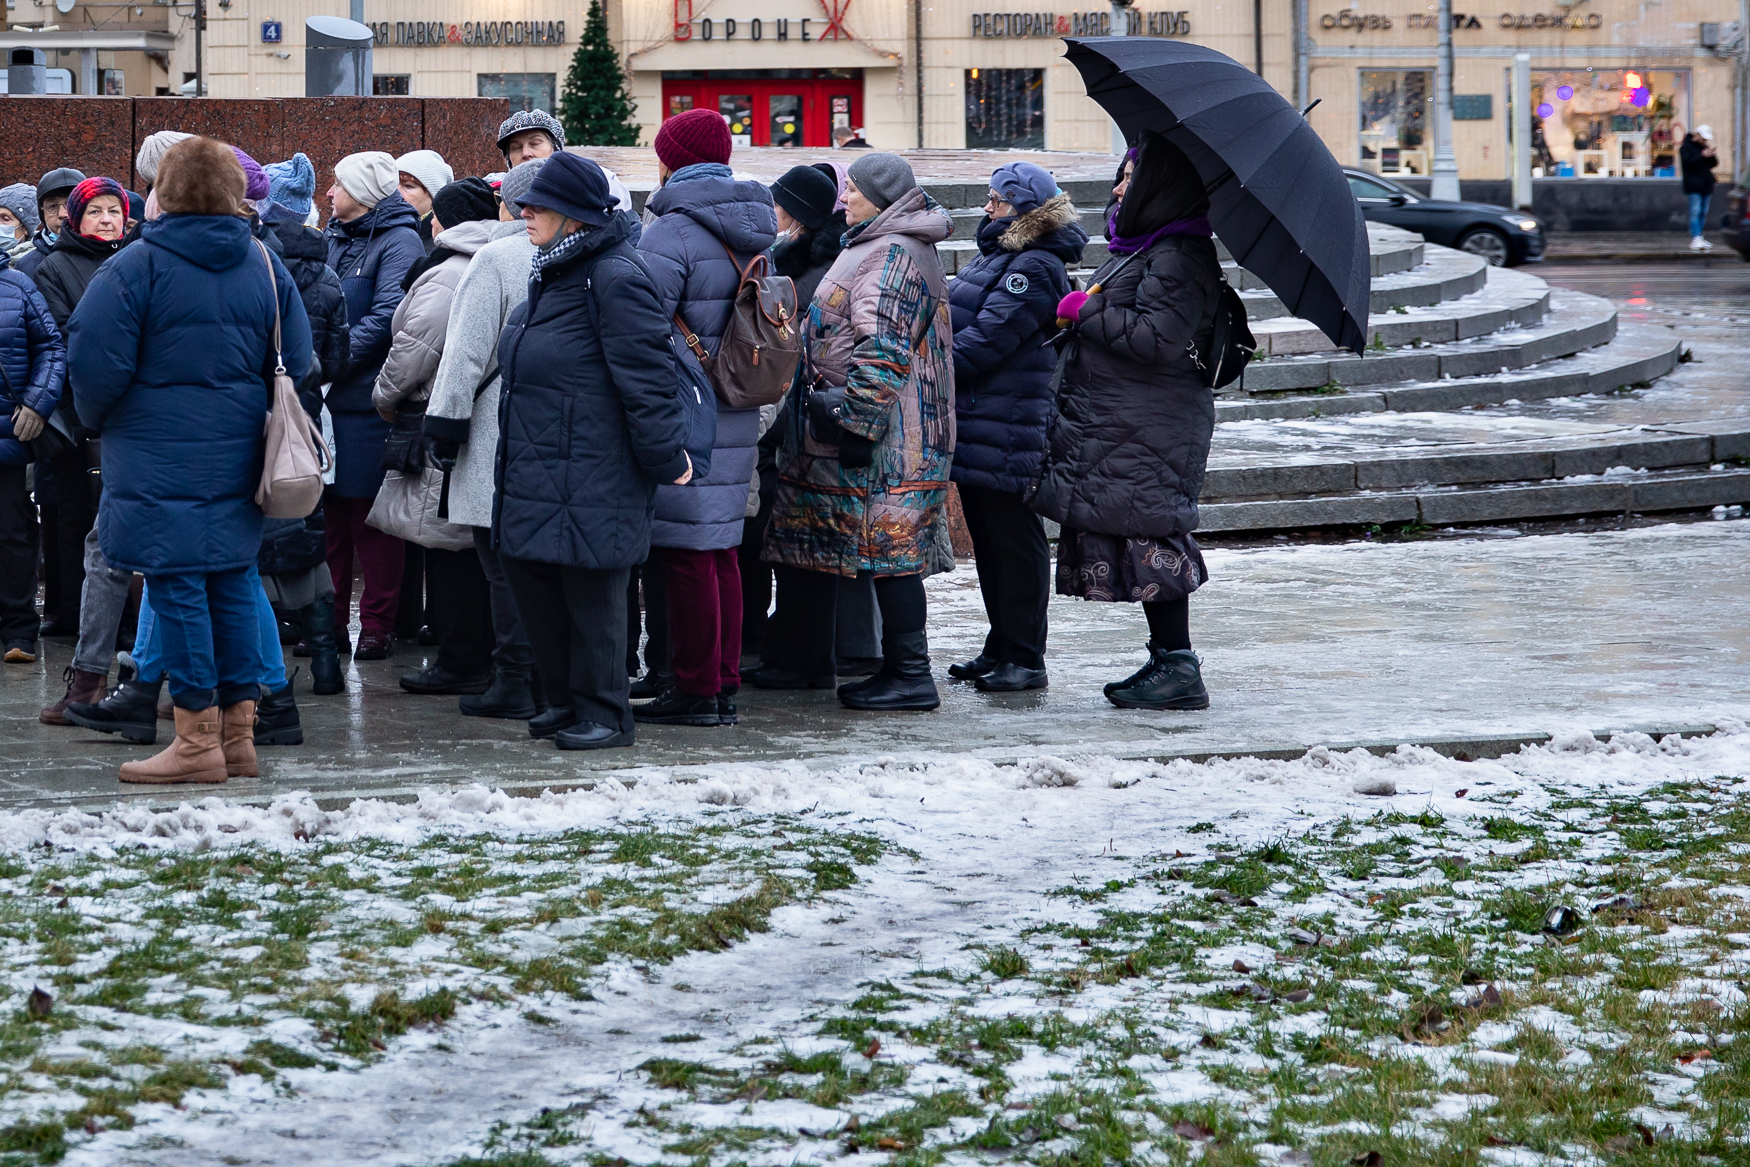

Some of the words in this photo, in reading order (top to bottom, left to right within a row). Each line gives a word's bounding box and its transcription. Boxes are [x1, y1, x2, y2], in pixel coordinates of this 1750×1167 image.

[265, 24, 277, 39] 4
[395, 21, 446, 45] ЛАВКА
[448, 24, 462, 42] &
[463, 20, 565, 45] ЗАКУСОЧНАЯ
[971, 13, 1054, 38] РЕСТОРАН
[1056, 15, 1070, 33] &
[1071, 10, 1142, 36] МЯСЙ
[1147, 10, 1190, 35] КЛУБ
